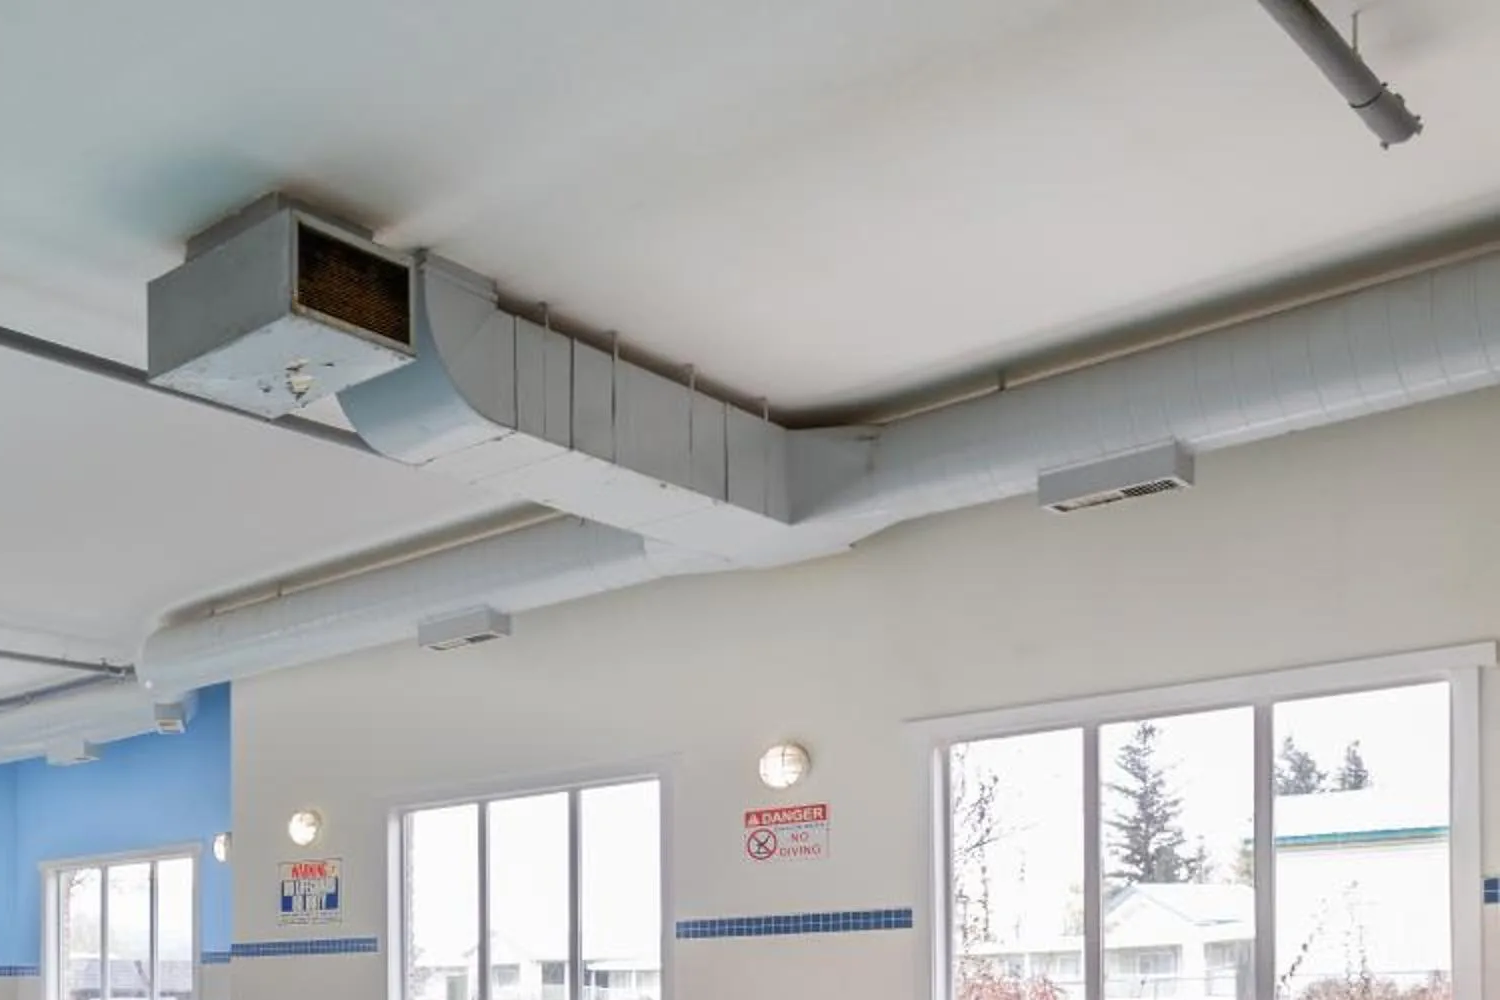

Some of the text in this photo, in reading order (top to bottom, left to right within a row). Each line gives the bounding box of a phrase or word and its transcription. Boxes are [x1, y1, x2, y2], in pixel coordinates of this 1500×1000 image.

[762, 806, 825, 825] DANGER
[791, 831, 810, 842] NO
[779, 844, 822, 858] DIVING
